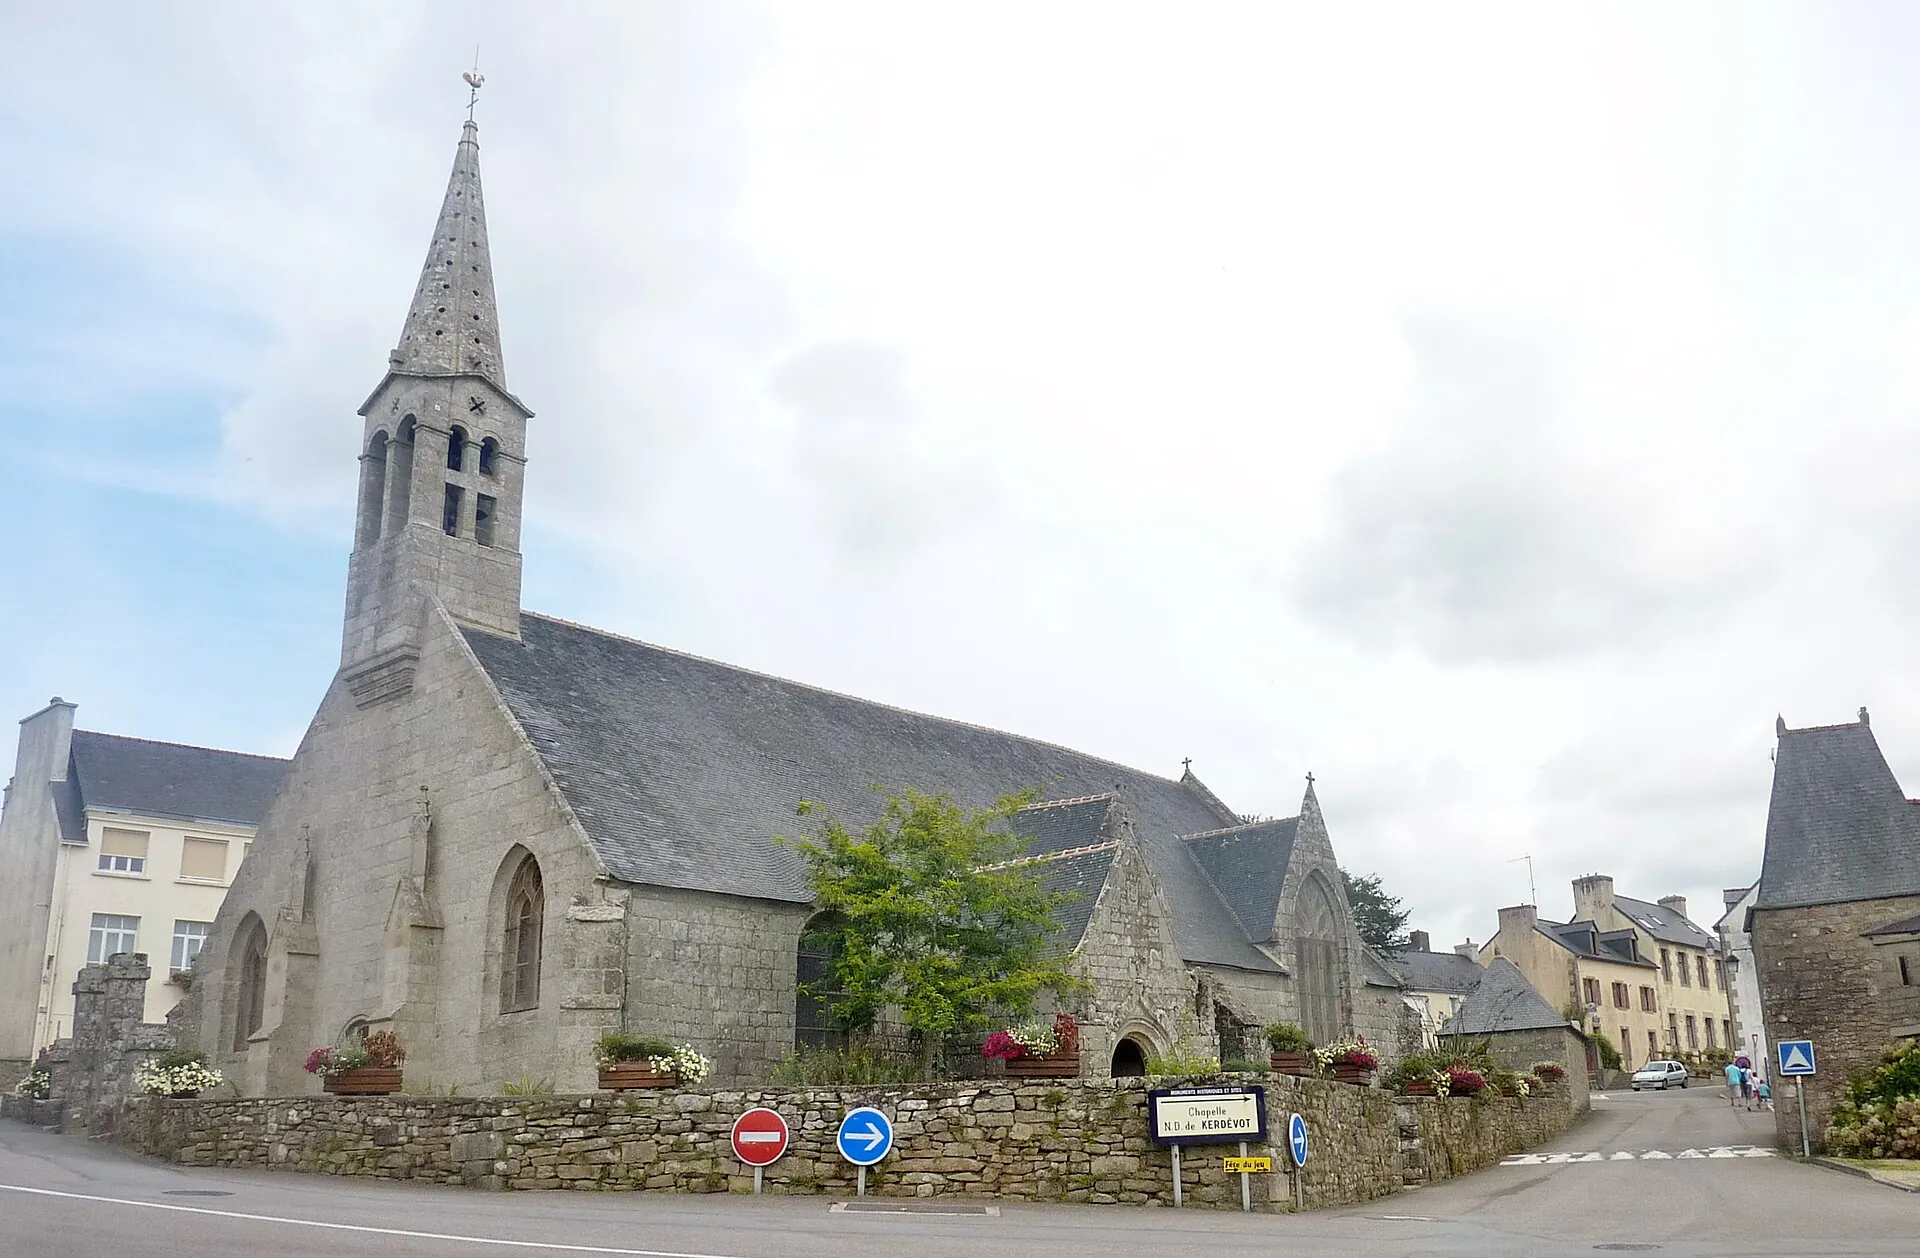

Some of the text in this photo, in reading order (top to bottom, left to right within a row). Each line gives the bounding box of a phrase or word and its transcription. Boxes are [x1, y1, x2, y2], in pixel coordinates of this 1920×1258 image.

[1188, 1106, 1226, 1118] Chapelle
[1184, 1121, 1196, 1130] de
[1202, 1118, 1251, 1130] KERDÉVOT
